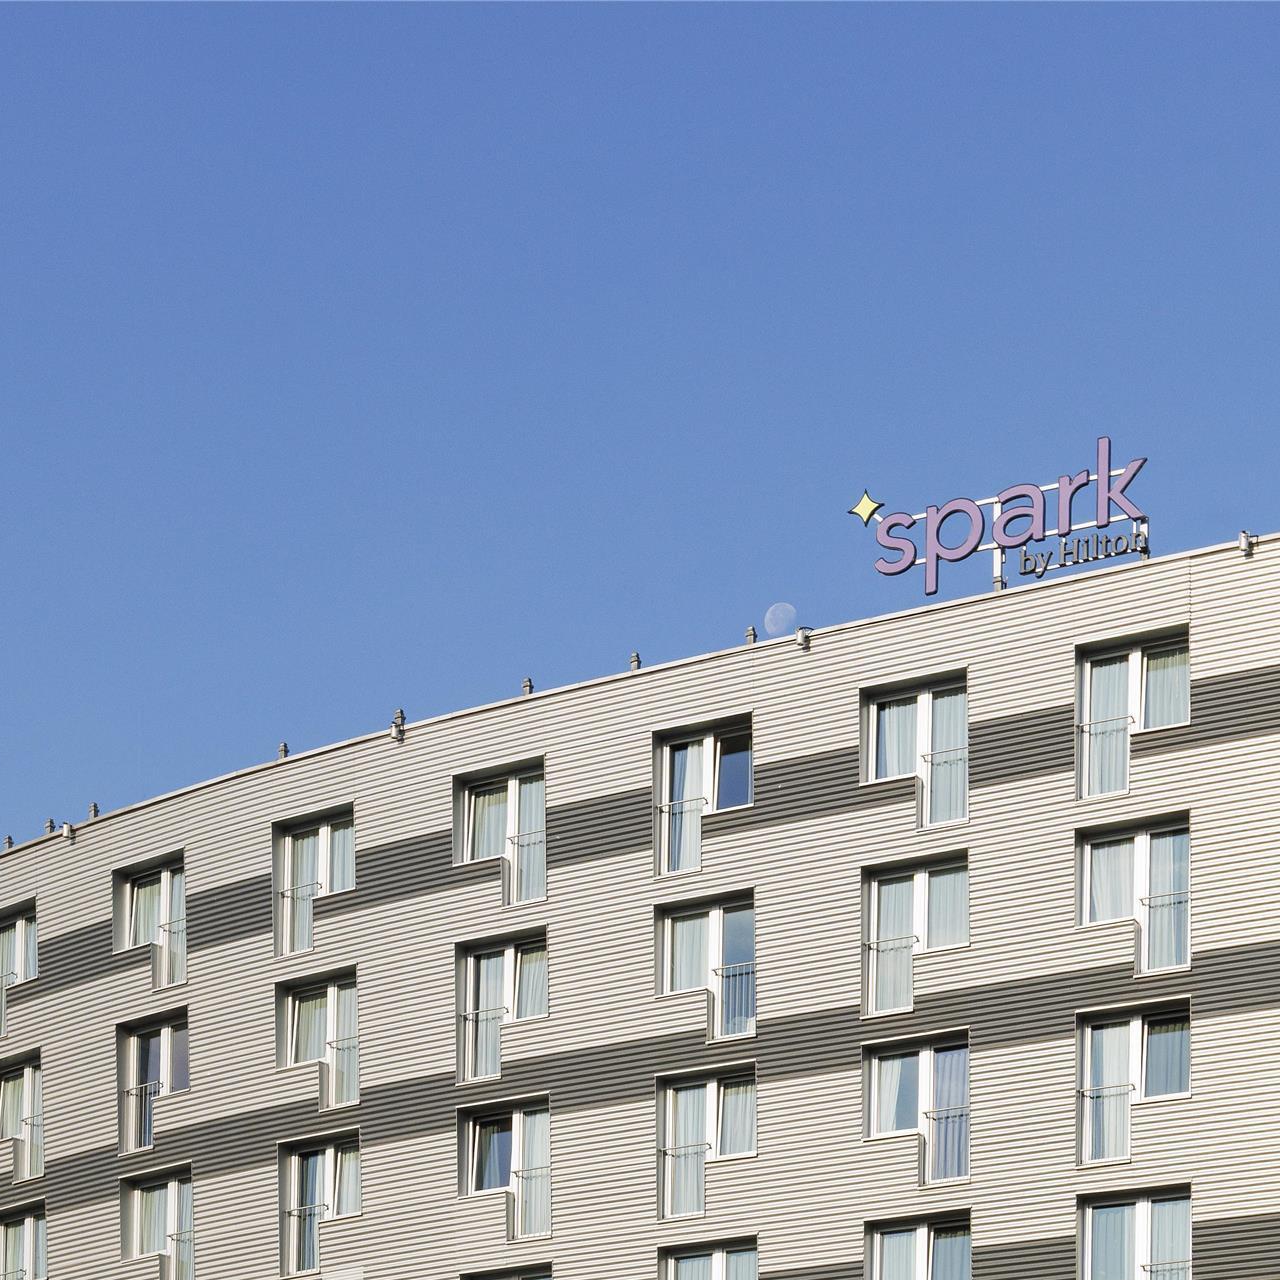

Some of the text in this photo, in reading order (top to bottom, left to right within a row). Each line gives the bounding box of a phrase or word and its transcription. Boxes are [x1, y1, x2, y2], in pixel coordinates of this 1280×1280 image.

[874, 437, 1147, 595] spark
[1019, 531, 1148, 578] by Hilton
